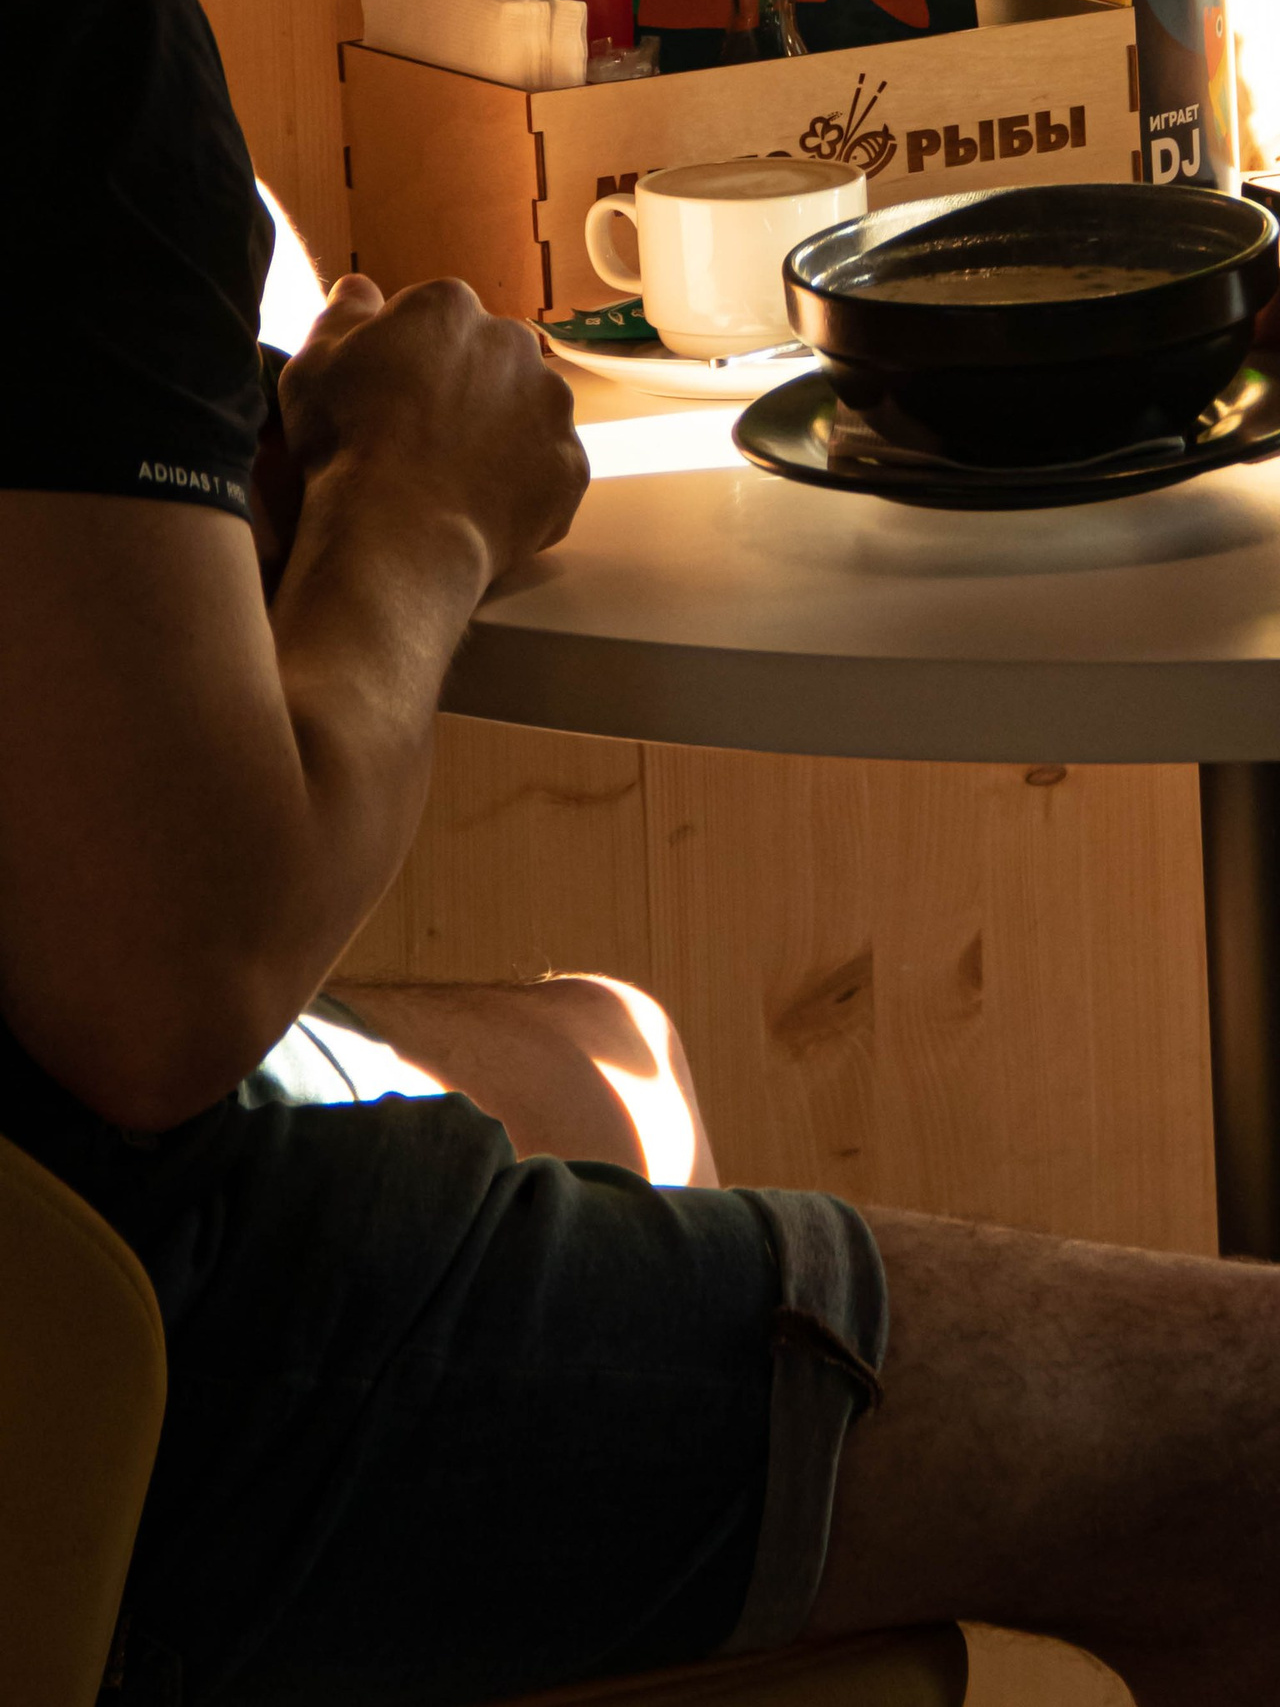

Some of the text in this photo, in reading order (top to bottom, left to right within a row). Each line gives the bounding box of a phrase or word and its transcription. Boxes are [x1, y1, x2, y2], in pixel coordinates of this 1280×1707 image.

[906, 105, 1086, 173] РЫБЫ
[1150, 103, 1200, 132] ИГРАЕТ
[1151, 128, 1201, 185] DJ
[138, 460, 211, 492] ADIDAS
